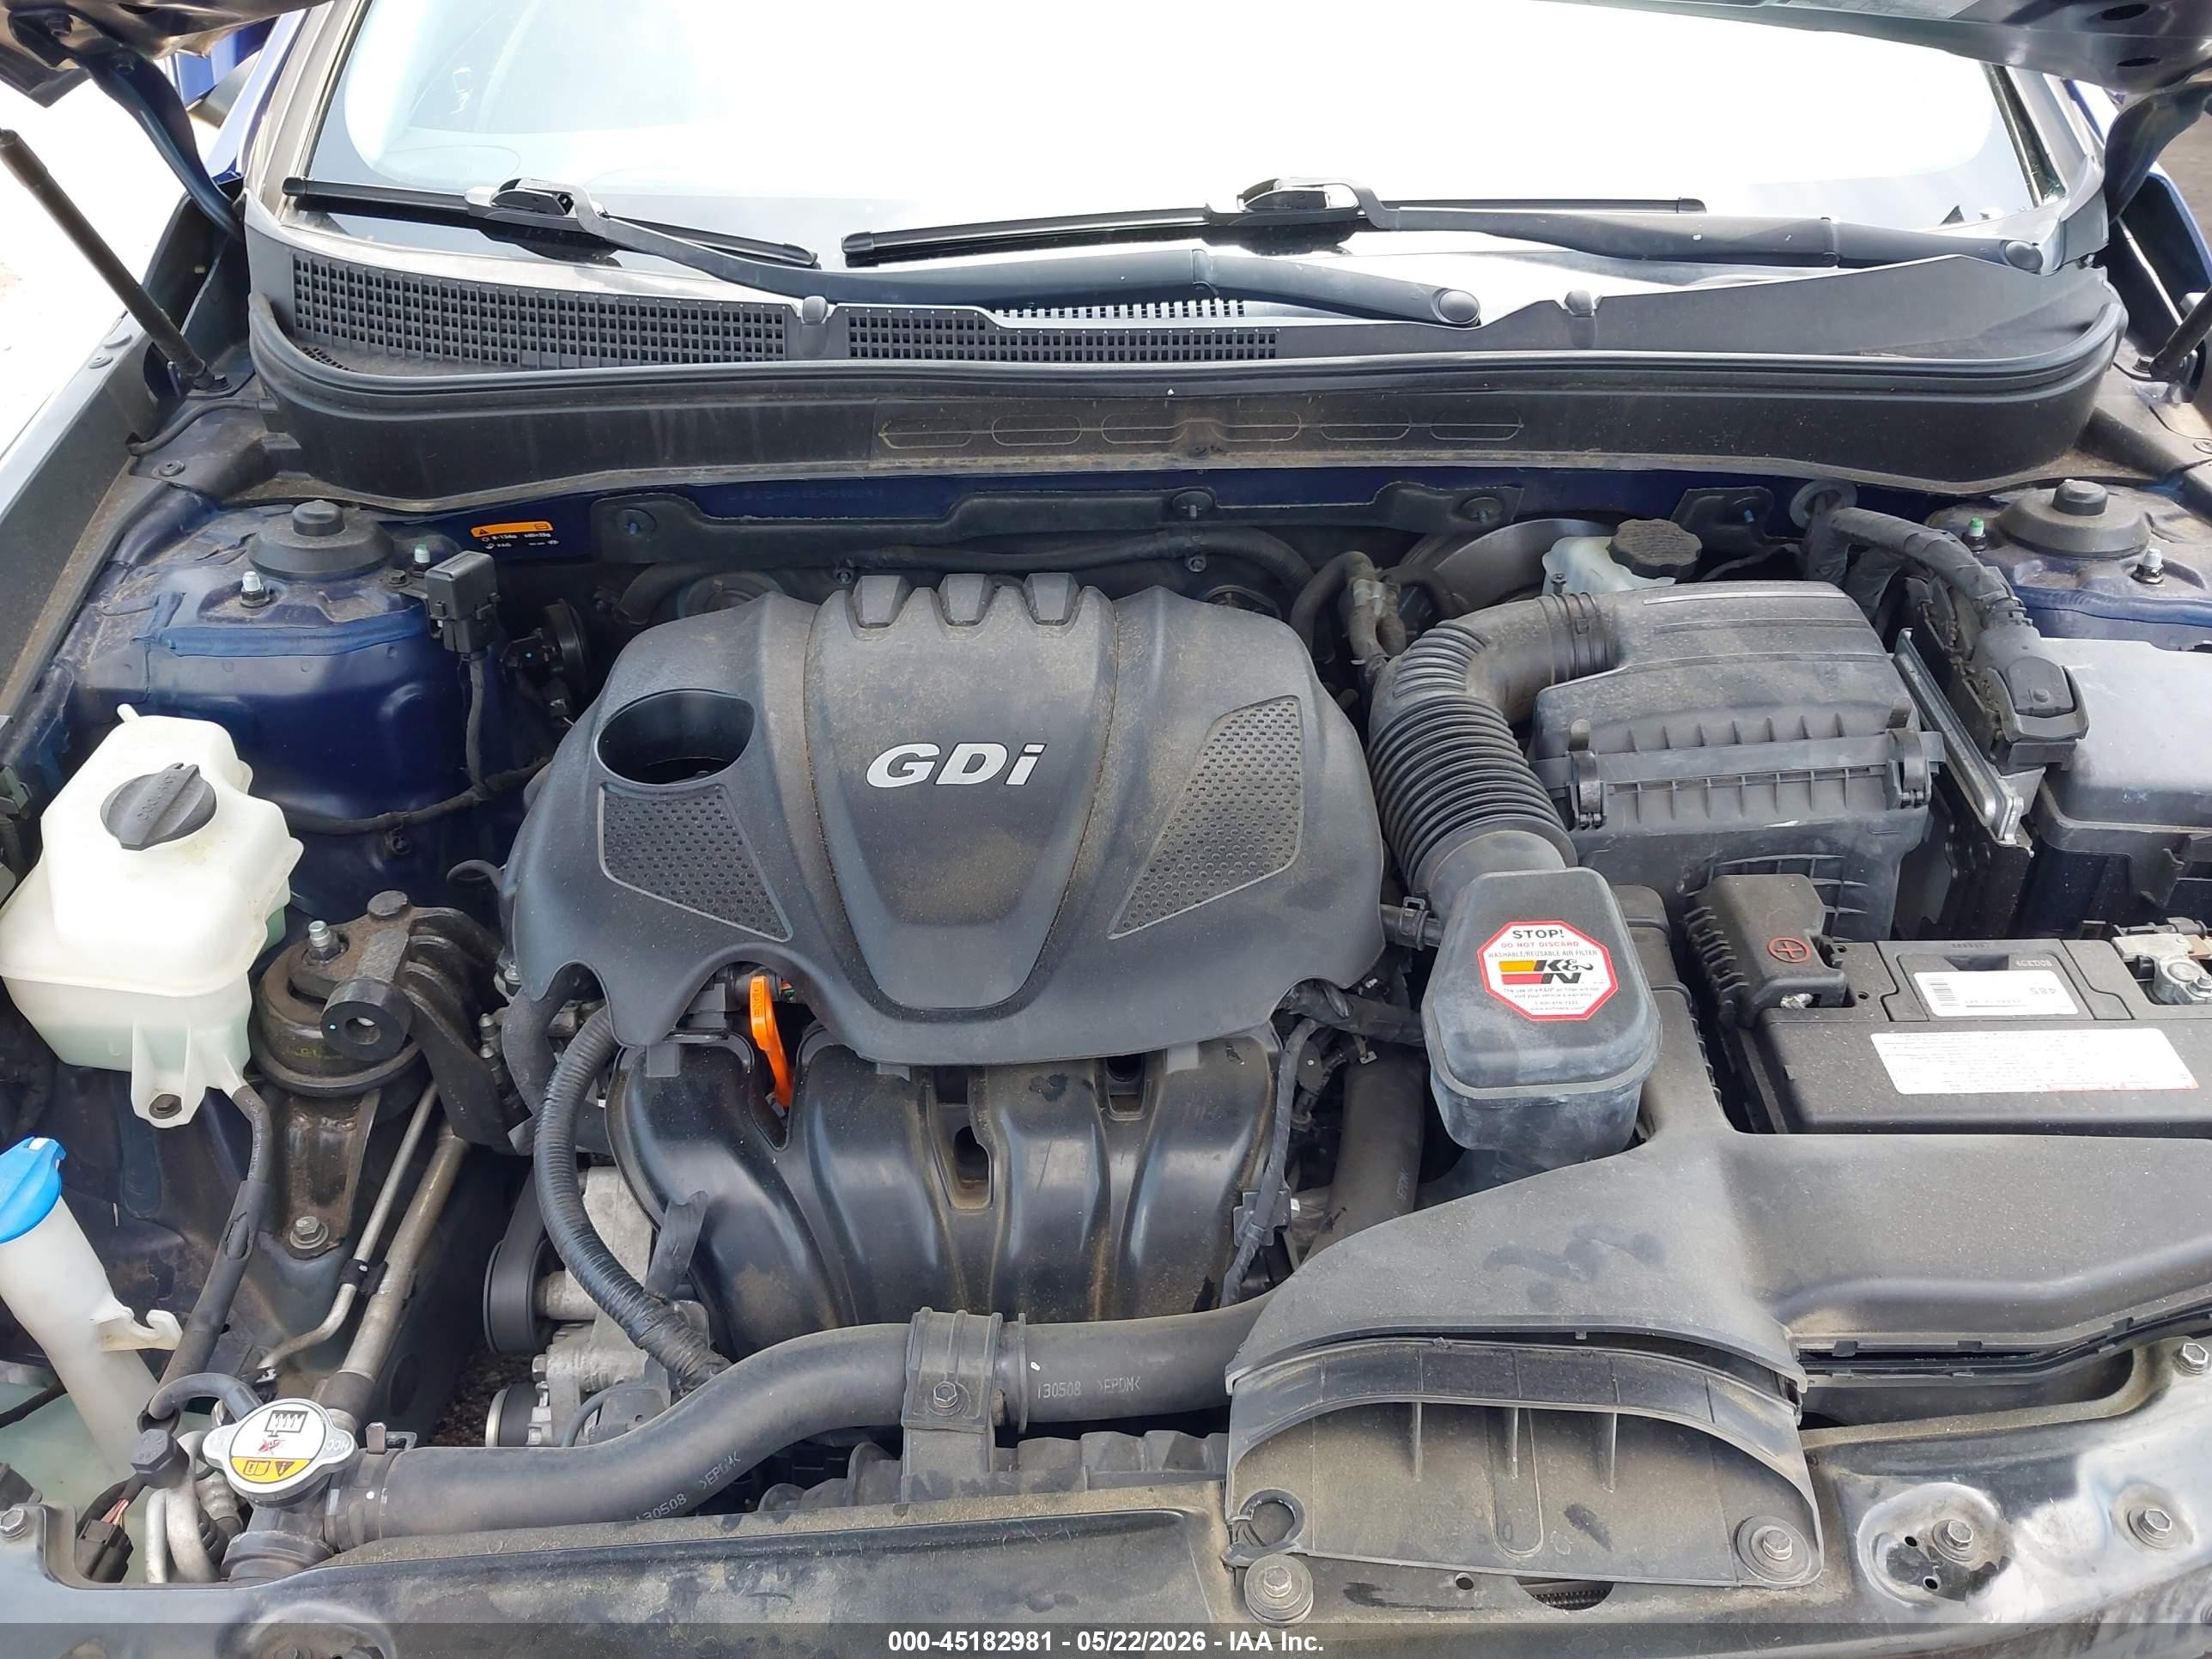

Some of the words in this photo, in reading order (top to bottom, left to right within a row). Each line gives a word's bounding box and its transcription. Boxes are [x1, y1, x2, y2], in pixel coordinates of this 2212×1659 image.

[866, 743, 1048, 788] GDi
[1512, 929, 1565, 939] STOP!
[1037, 1381, 1081, 1399] 130508
